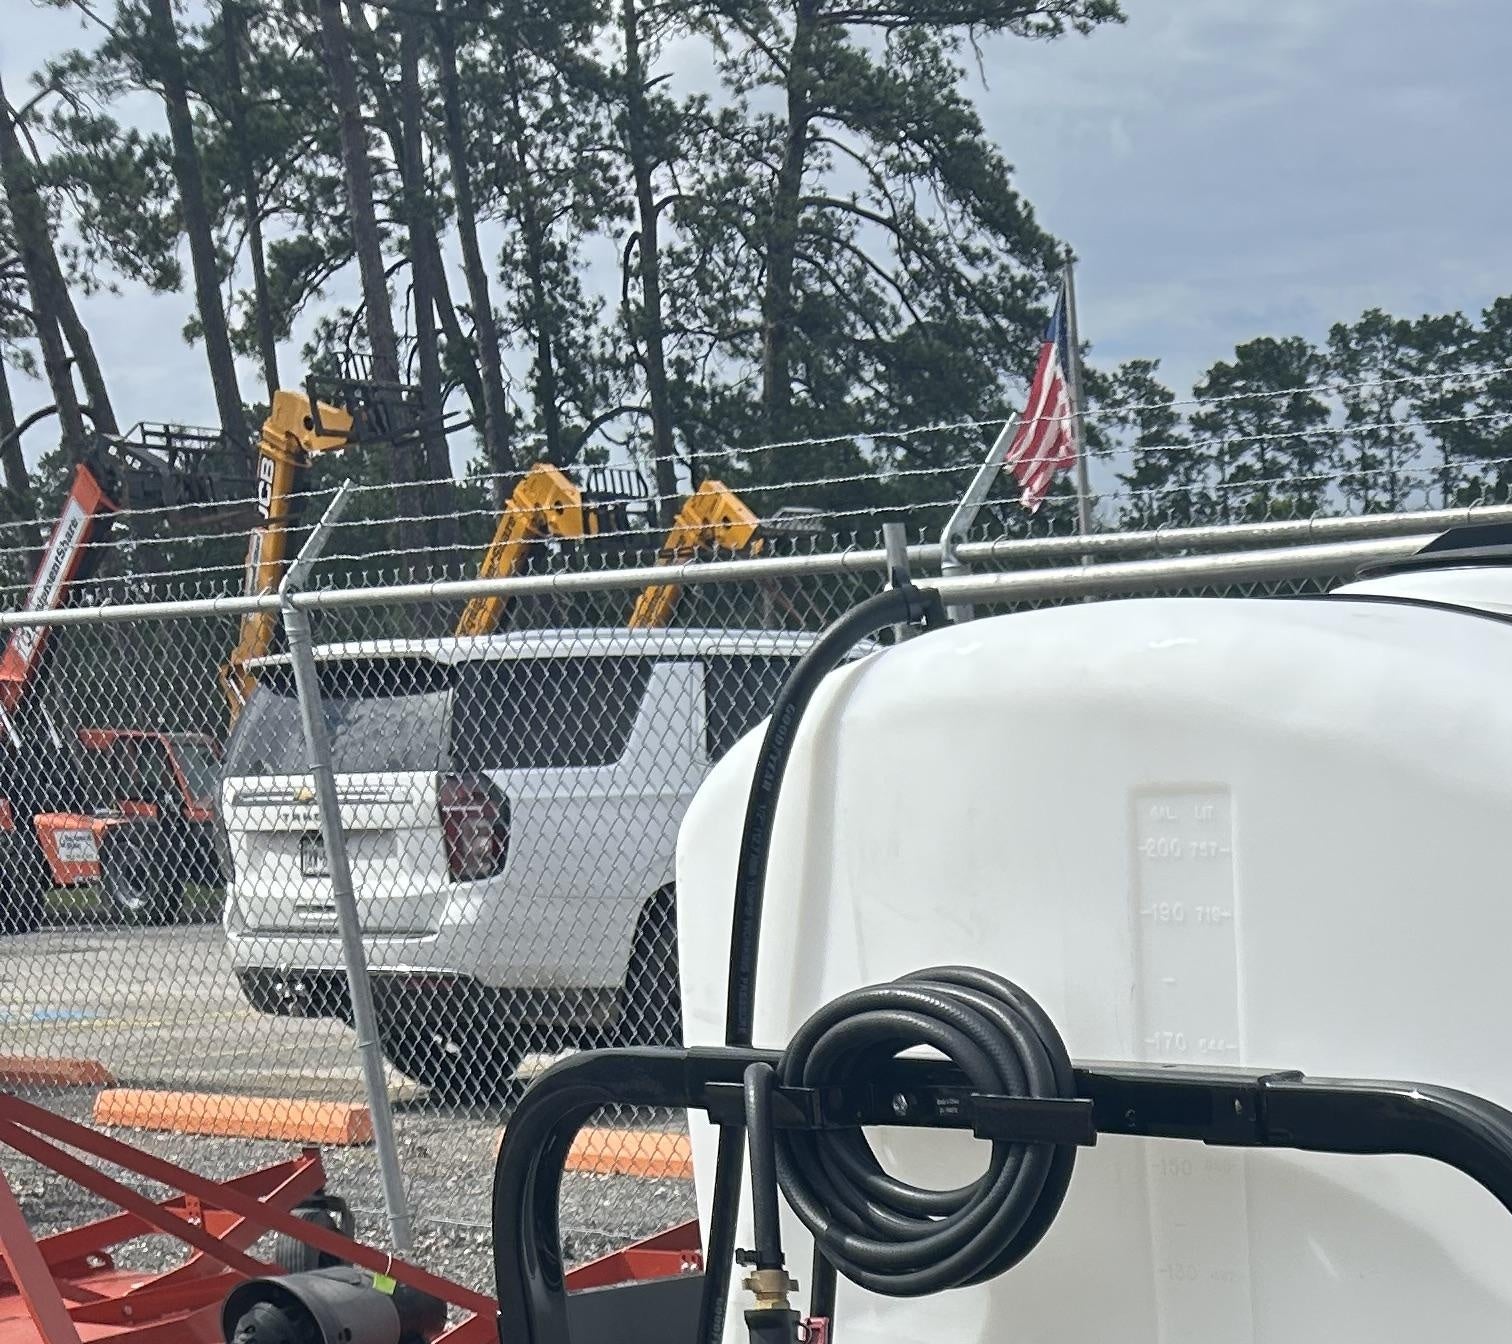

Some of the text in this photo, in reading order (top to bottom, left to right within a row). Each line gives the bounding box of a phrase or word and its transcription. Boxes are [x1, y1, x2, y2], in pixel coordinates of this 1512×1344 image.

[257, 456, 277, 521] JCB
[1147, 838, 1181, 857] 200
[1152, 902, 1184, 921] 190
[1154, 1032, 1187, 1051] 170
